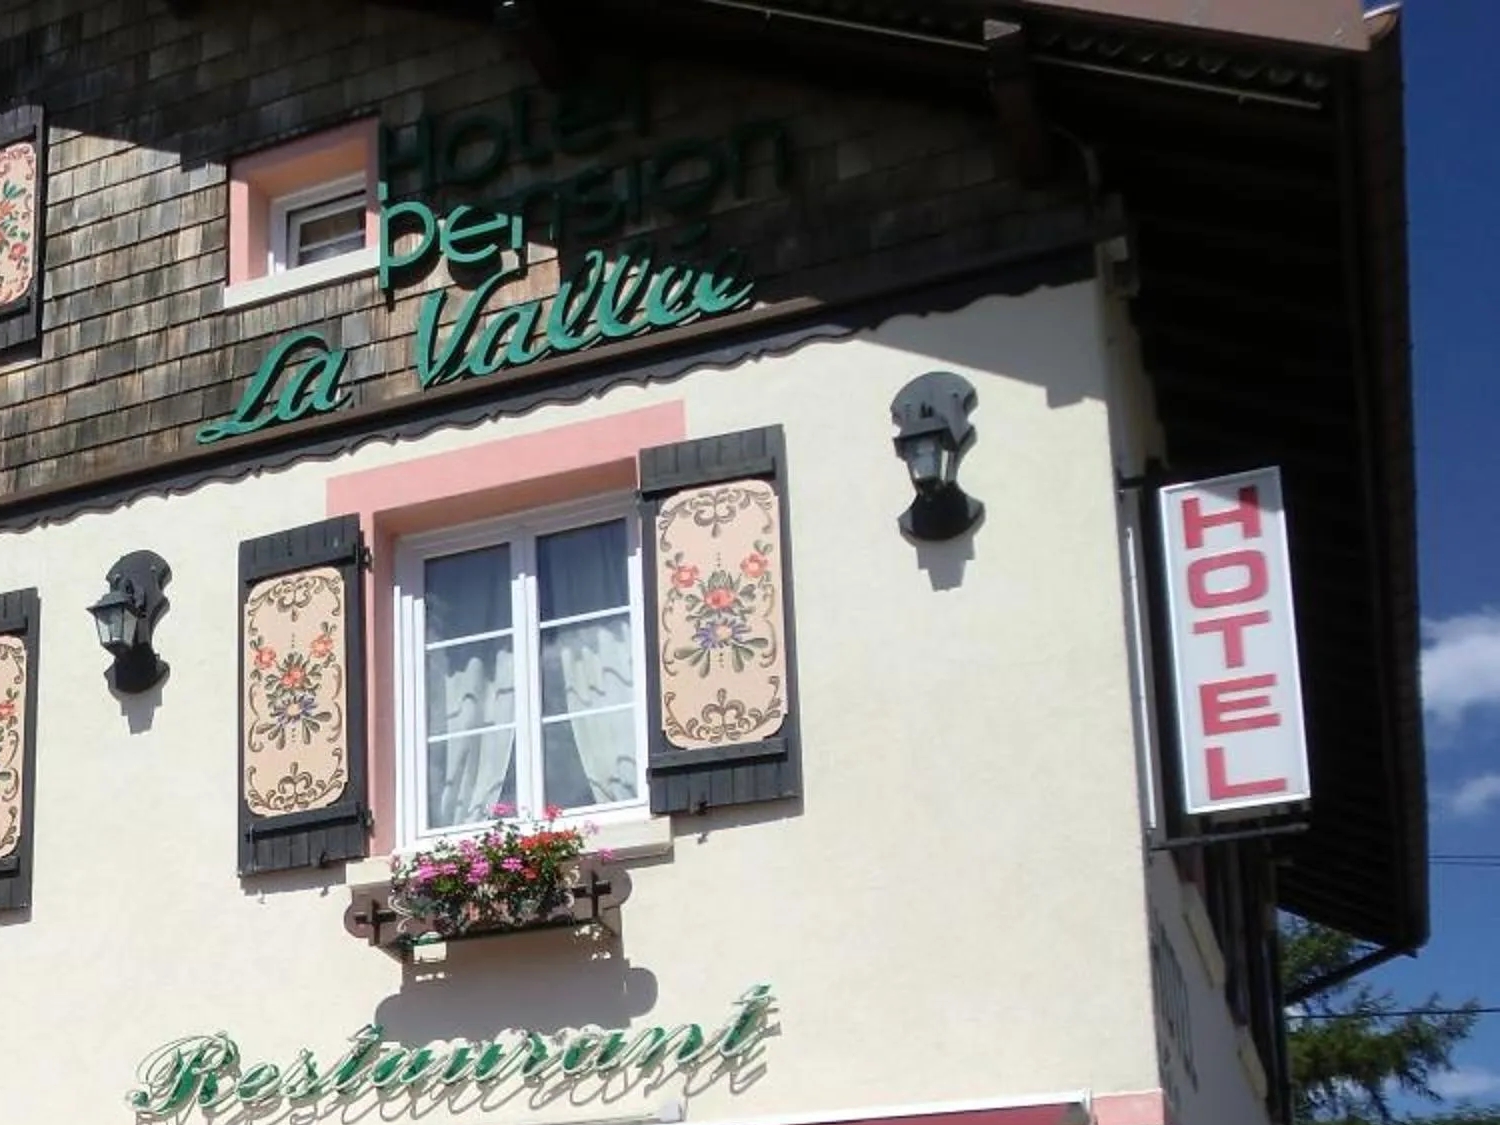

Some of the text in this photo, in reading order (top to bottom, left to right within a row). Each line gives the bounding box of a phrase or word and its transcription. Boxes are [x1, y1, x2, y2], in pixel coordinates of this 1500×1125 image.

[197, 330, 353, 444] La
[1180, 485, 1288, 801] HOTEL
[125, 984, 773, 1115] Restaurant
